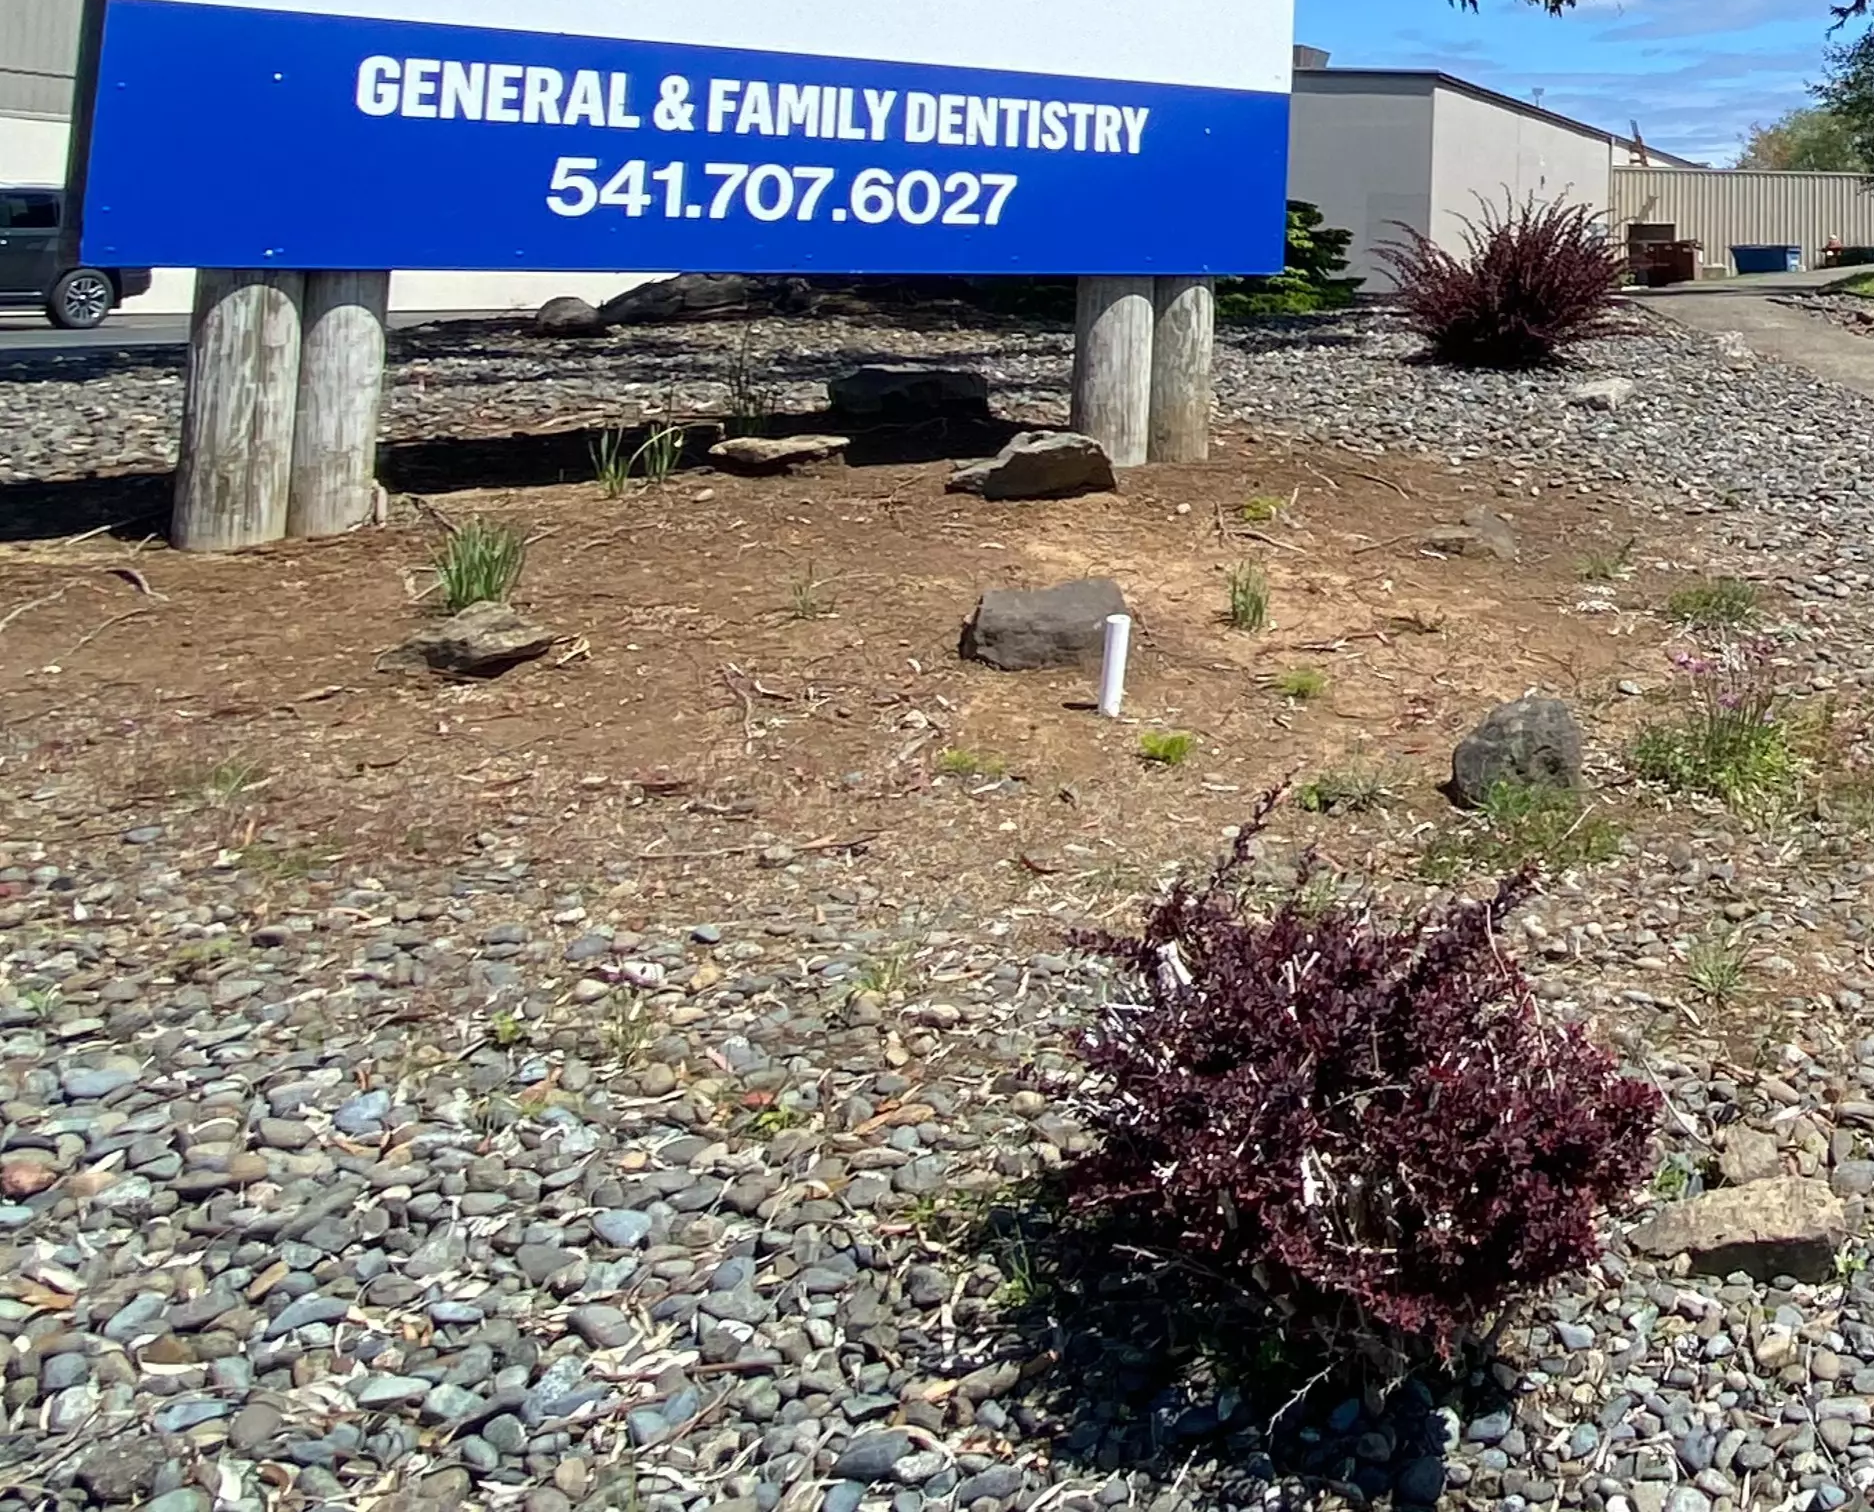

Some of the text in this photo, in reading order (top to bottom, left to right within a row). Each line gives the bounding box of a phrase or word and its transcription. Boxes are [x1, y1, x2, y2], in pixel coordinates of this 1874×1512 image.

[357, 56, 1150, 154] GENERAL & FAMILY DENTISTRY
[547, 157, 1018, 225] 541.707.6027
